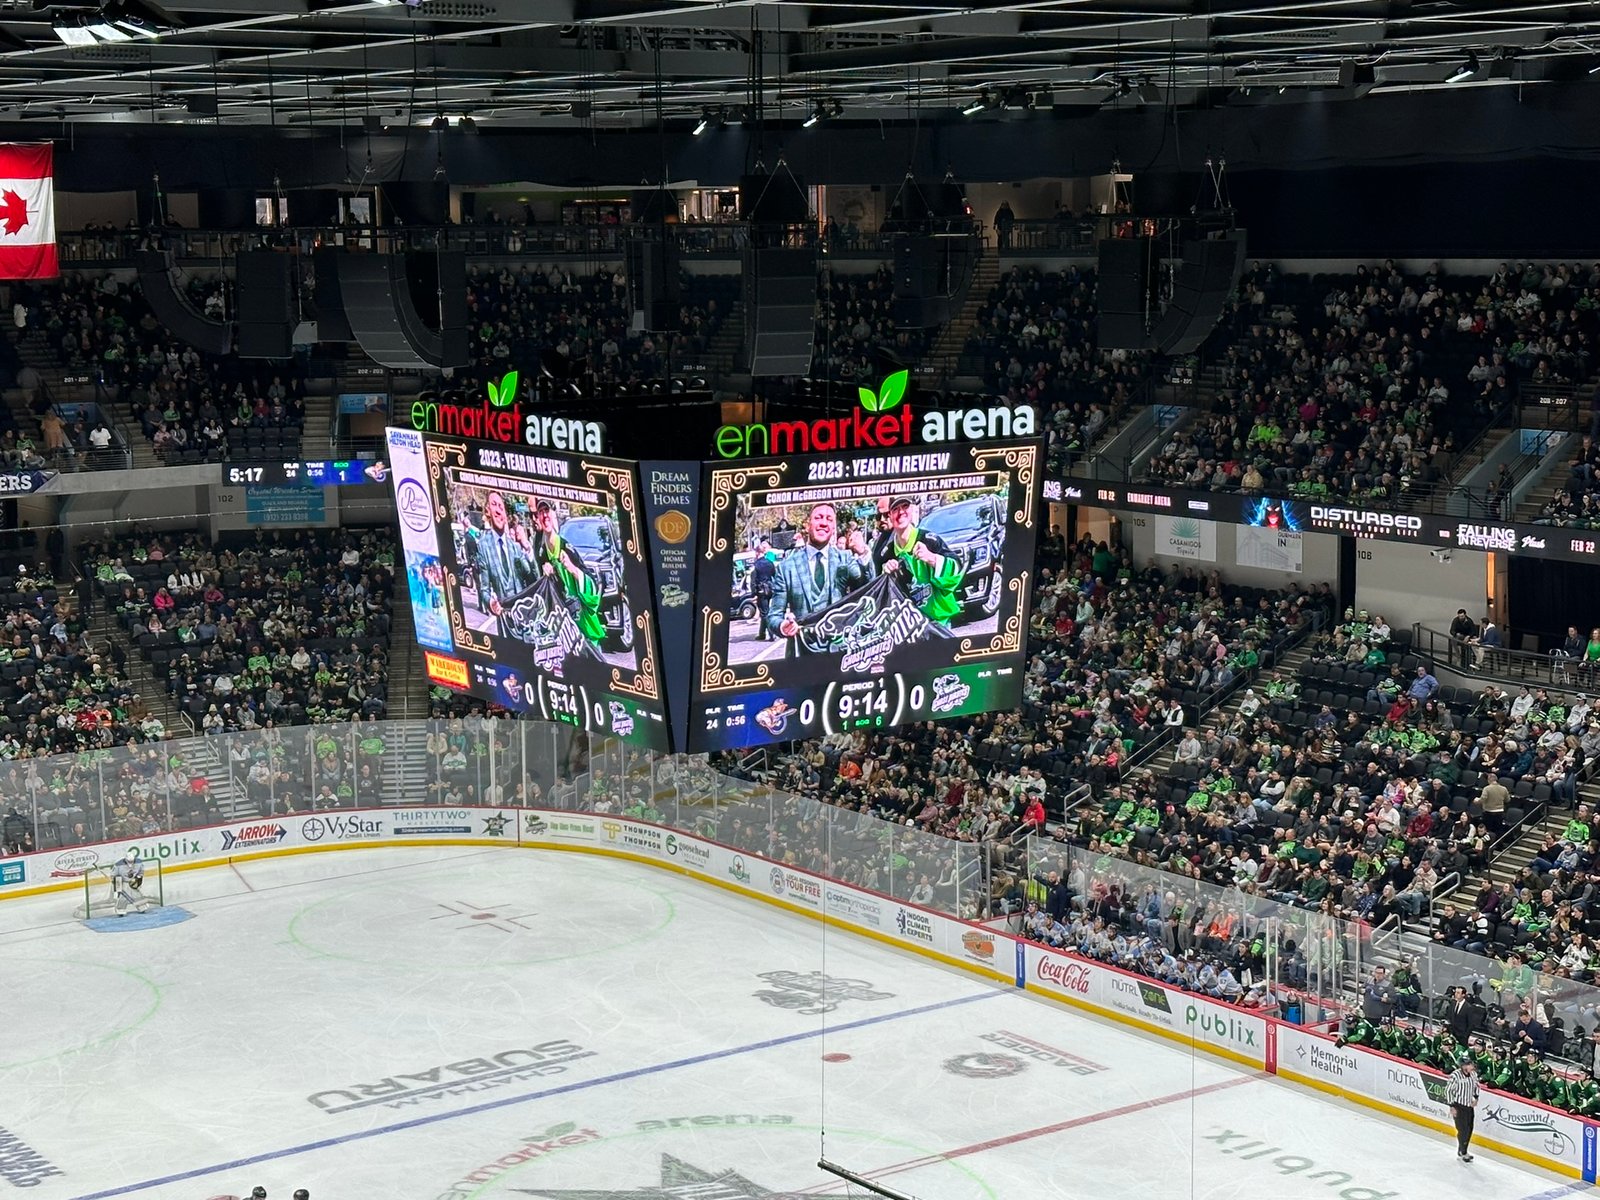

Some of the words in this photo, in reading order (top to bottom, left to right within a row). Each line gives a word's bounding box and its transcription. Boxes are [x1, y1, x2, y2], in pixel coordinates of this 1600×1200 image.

[411, 400, 521, 443] enmarket
[526, 414, 602, 453] arena
[716, 404, 913, 458] enmarket
[922, 405, 1035, 443] arena
[408, 440, 421, 448] HEAD
[479, 449, 501, 468] 2023
[504, 452, 526, 472] YEAR
[526, 456, 536, 474] IN
[536, 458, 568, 478] REVIEW
[808, 460, 843, 480] 2023
[852, 458, 884, 476] YEAR
[886, 456, 900, 474] IN
[902, 452, 950, 473] REVIEW
[230, 468, 264, 482] 5:17
[286, 470, 296, 478] 24
[339, 471, 344, 481] 1
[652, 471, 689, 482] DREAM
[0, 475, 32, 492] ERS
[650, 483, 692, 494] FINDERS
[766, 491, 792, 504] CONOR
[792, 489, 832, 502] McGREGOR
[832, 487, 851, 498] WITH
[852, 486, 866, 496] THE
[866, 484, 890, 494] GHOST
[890, 481, 918, 493] PIRATES
[919, 480, 928, 490] AT
[928, 479, 939, 490] ST.
[940, 478, 958, 489] PAT'S
[959, 476, 985, 488] PARADE
[1044, 480, 1061, 491] ING
[218, 495, 233, 503] 102
[654, 494, 690, 505] HOMES
[1098, 490, 1107, 500] FEB
[1108, 490, 1115, 501] 22
[1127, 492, 1153, 505] ENMARKET
[1154, 494, 1172, 507] ARENA
[1133, 518, 1145, 527] 105
[1310, 506, 1422, 530] DISTURBED
[664, 522, 684, 534] DF
[1457, 524, 1516, 540] FALLING
[1169, 538, 1201, 549] CASAMIGOS
[1278, 538, 1286, 547] IN
[1458, 534, 1469, 546] IN
[1470, 536, 1518, 551] REVERSE
[1571, 540, 1584, 552] FEB
[1585, 541, 1595, 554] 22
[1358, 550, 1372, 560] 106
[525, 682, 534, 705] 0
[842, 681, 874, 693] PERIOD
[550, 690, 577, 715] 9:14
[838, 692, 888, 719] 9:14
[910, 685, 924, 710] 0
[594, 702, 604, 726] 0
[705, 707, 720, 715] PLR
[727, 704, 745, 712] TIME
[800, 699, 814, 724] 0
[706, 719, 718, 730] 24
[726, 716, 745, 727] 0:56
[876, 716, 882, 728] 6
[237, 824, 277, 841] ARROW
[324, 815, 383, 839] VyStar
[624, 825, 661, 839] THOMPSON
[235, 837, 277, 849] EXTERMINATORS
[624, 836, 661, 850] THOMPSON
[678, 842, 710, 858] goosehead
[786, 873, 799, 882] LOCAL
[785, 878, 804, 892] TOUR
[805, 885, 821, 898] FREE
[907, 912, 929, 924] INDOOR
[907, 920, 932, 933] CLIMATE
[907, 927, 933, 942] EXPERTS
[1038, 955, 1092, 994] Coca-Cola
[1185, 1004, 1257, 1047] Publix
[977, 1033, 1098, 1075] BADGER
[1310, 1045, 1358, 1070] Memorial
[307, 1039, 583, 1109] SUBARU
[1310, 1056, 1342, 1076] Health
[383, 1066, 568, 1109] CHATHAM
[1499, 1107, 1556, 1126] Crosswinds
[0, 1125, 66, 1178] VANNAH
[433, 1127, 601, 1200] enmarket
[635, 1113, 794, 1132] arena
[1201, 1129, 1400, 1200] Publix
